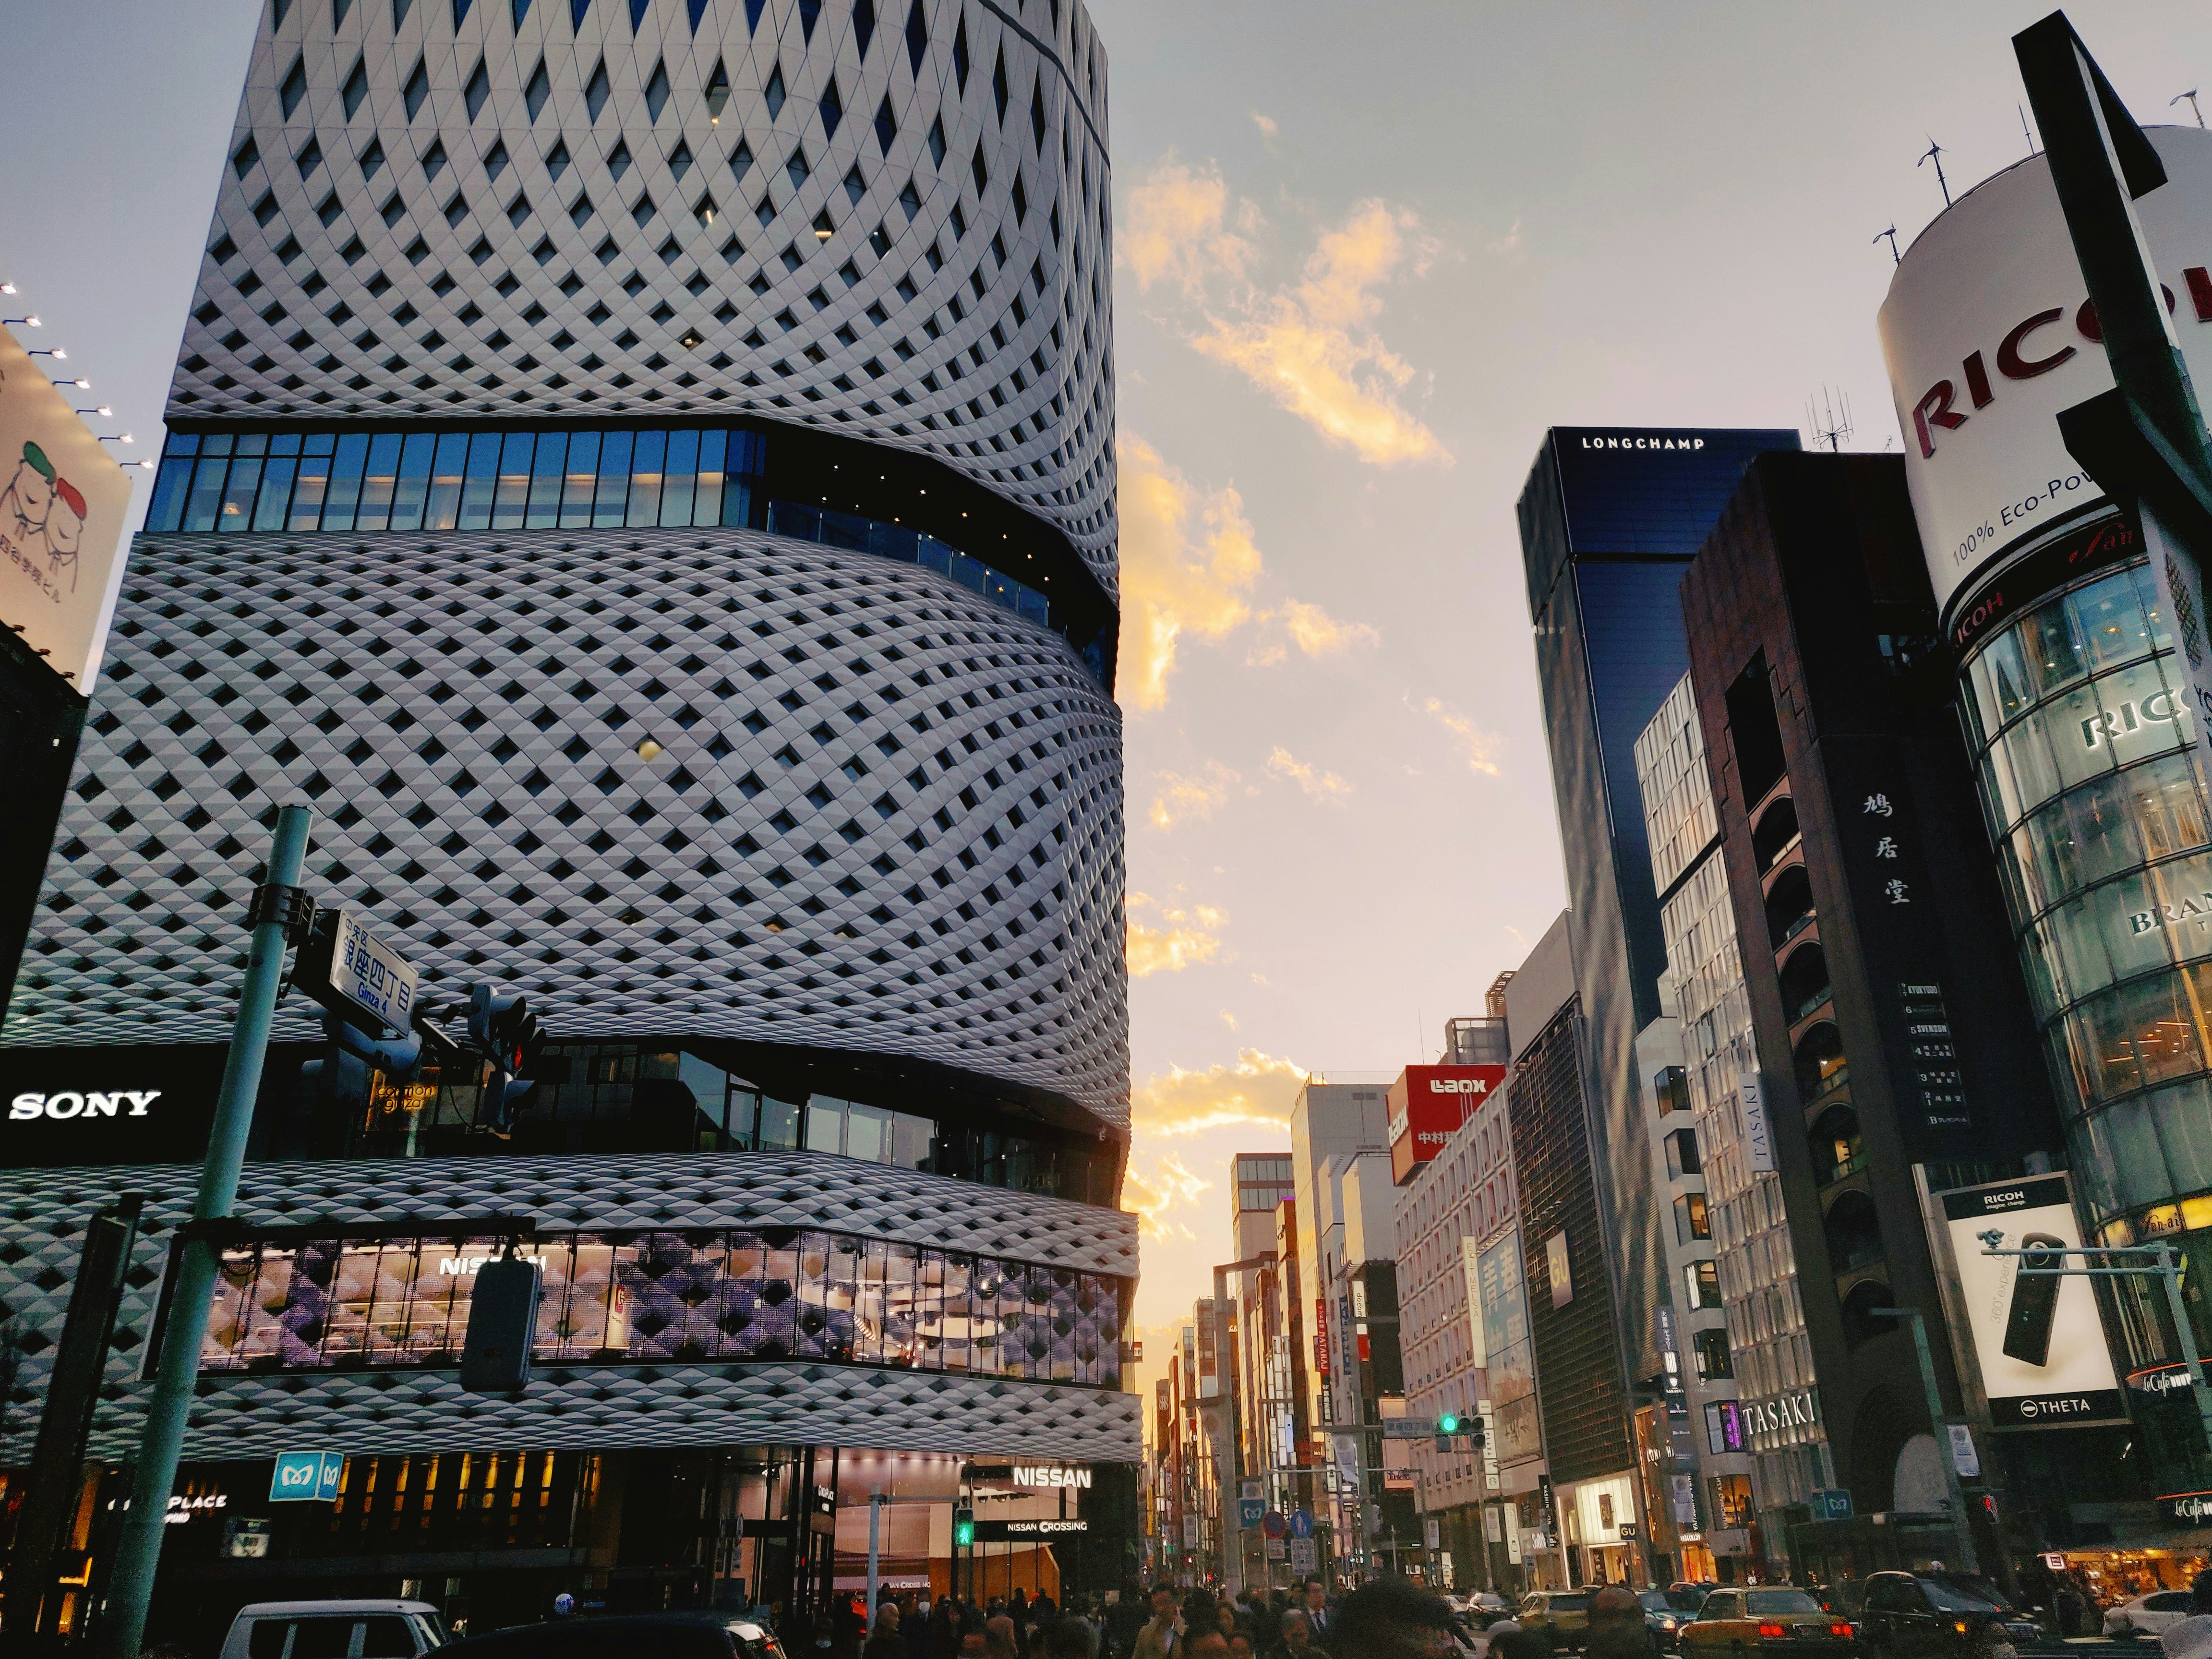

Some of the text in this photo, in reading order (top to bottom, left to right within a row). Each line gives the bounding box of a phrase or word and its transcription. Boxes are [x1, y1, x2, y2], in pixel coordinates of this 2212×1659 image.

[1583, 437, 1705, 449] LONGCHAMP
[1953, 520, 1994, 566] 100%
[1953, 591, 2003, 648] ICOH
[1863, 793, 1911, 904] 鳩居堂
[345, 918, 369, 947] 中央区
[343, 935, 410, 1012] 銀座四丁目
[358, 982, 387, 1014] Ginza 4
[8, 1090, 162, 1120] SONY
[1743, 1085, 1767, 1161] TASAKI
[1984, 1191, 2025, 1204] RICOH
[439, 1256, 547, 1275] NISN
[1551, 1252, 1568, 1288] GU
[1997, 1233, 2016, 1298] experiece.
[1319, 1331, 1328, 1370] NATARAJ
[1742, 1393, 1815, 1435] TASAKI
[2038, 1398, 2091, 1414] THETA
[1014, 1467, 1091, 1488] NISSAN
[168, 1495, 227, 1510] PLACE
[1008, 1523, 1037, 1532] NISSAN
[1621, 1527, 1635, 1536] GU
